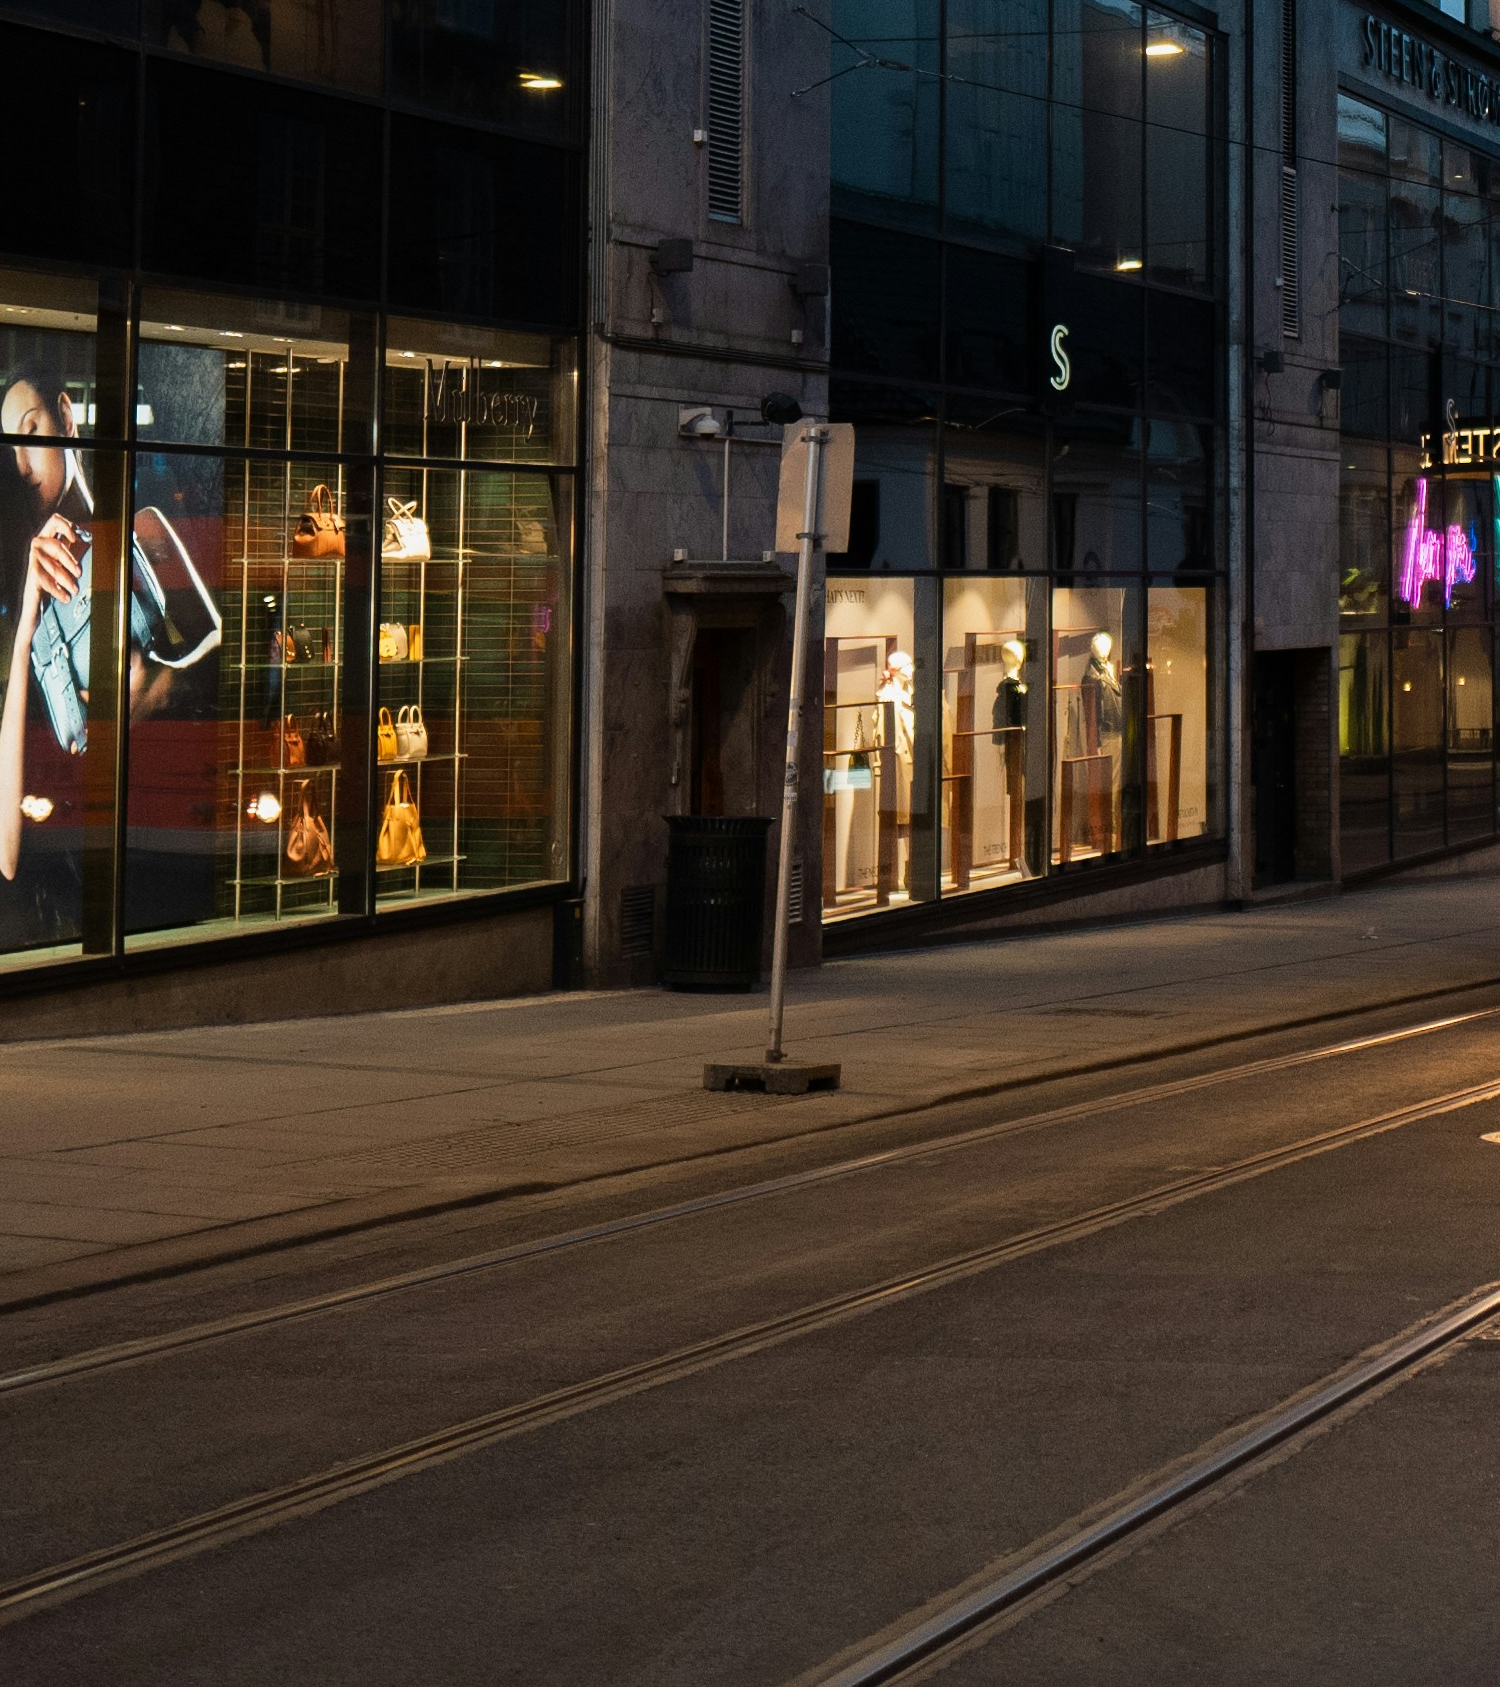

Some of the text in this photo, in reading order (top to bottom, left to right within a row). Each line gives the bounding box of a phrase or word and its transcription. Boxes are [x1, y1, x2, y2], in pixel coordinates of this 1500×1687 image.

[1363, 15, 1500, 127] STEEN & STRØM
[422, 356, 538, 445] Mulberry
